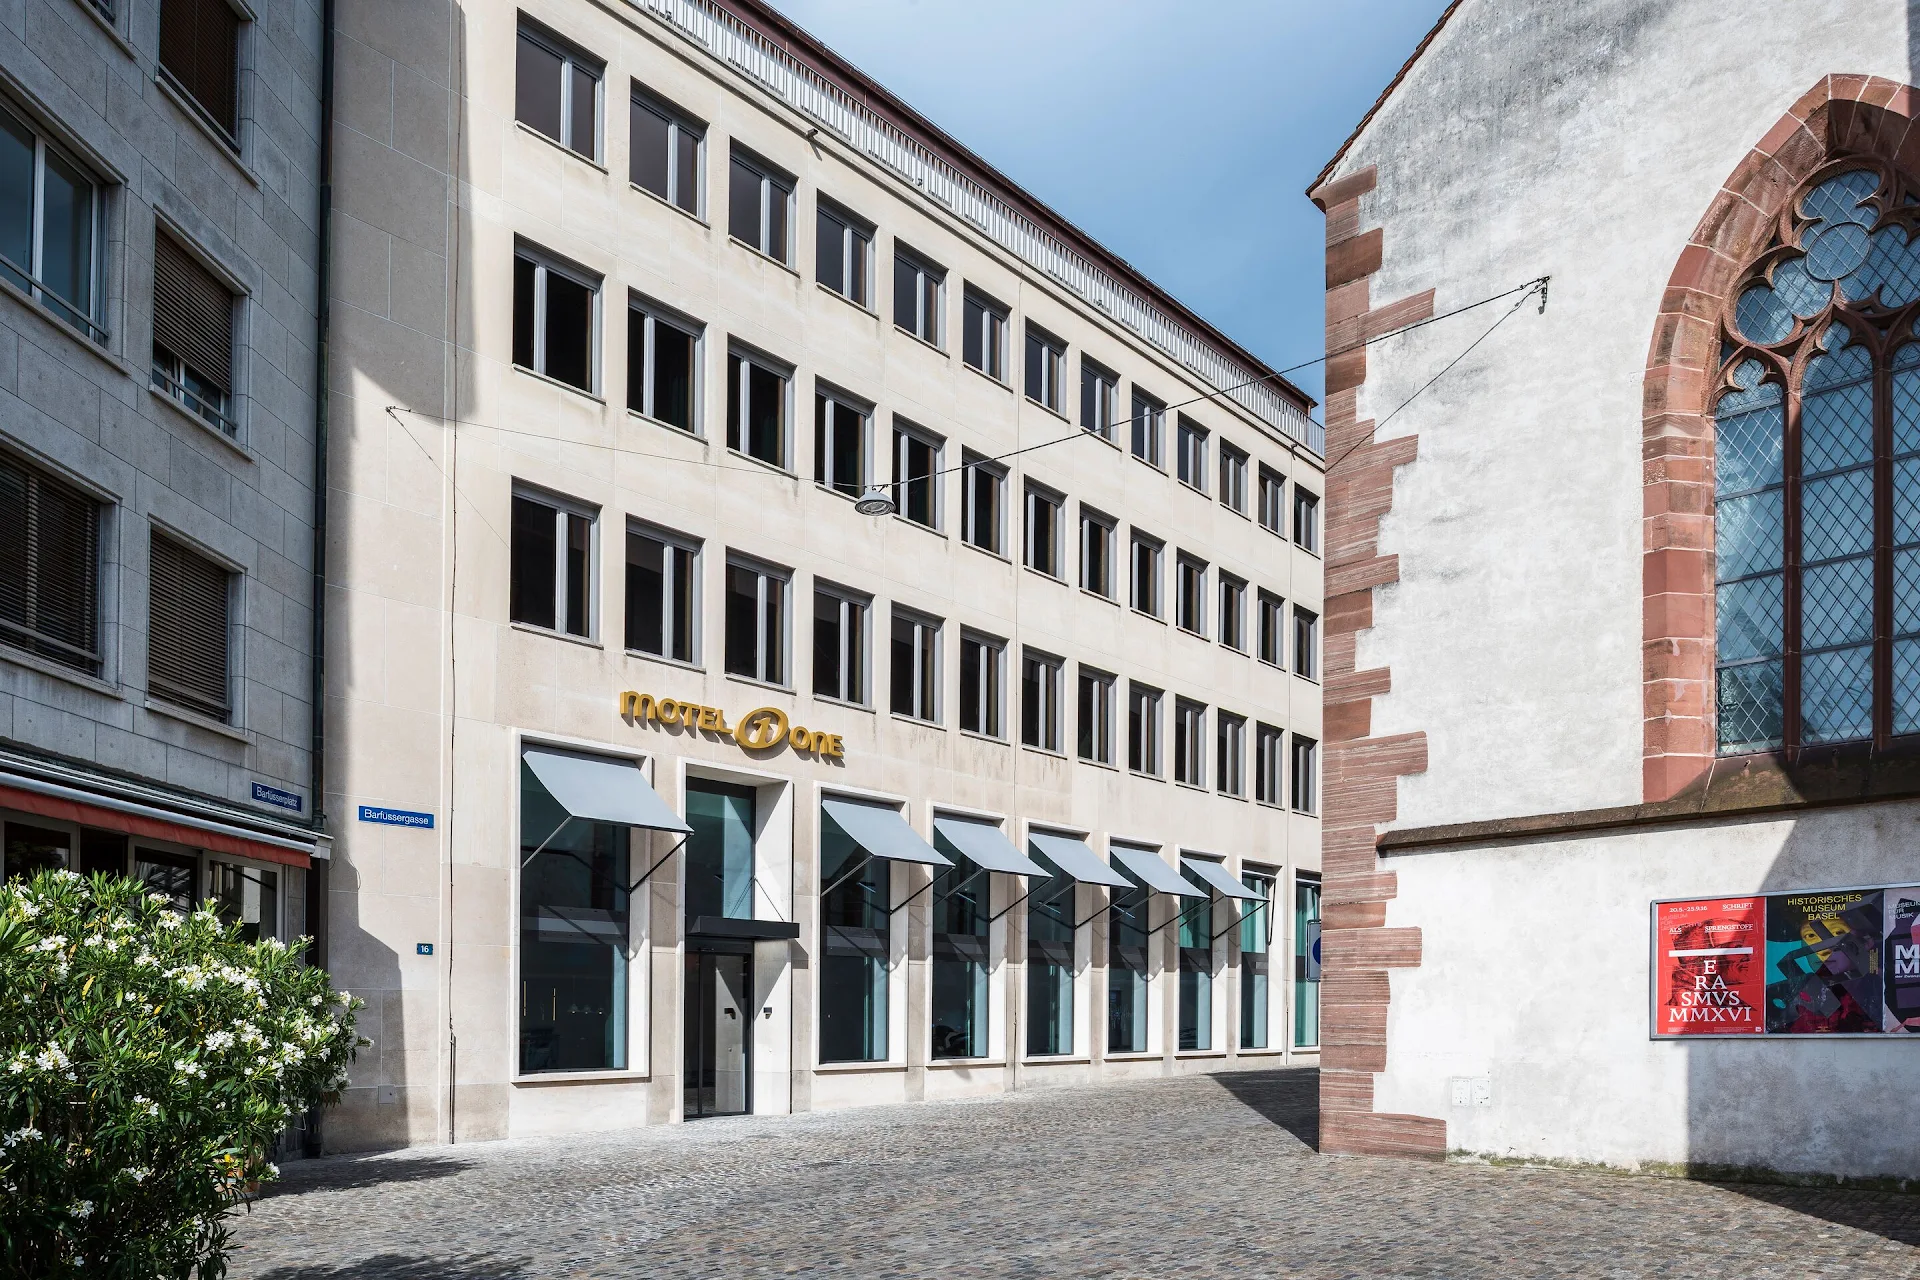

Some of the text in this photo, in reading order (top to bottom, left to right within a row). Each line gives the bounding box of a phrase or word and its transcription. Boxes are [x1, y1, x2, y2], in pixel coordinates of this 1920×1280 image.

[620, 690, 733, 734] MOTEL
[789, 726, 843, 757] ONE
[256, 787, 298, 807] Barfüsserplatz
[364, 809, 429, 825] Barfüssergasse
[1722, 902, 1753, 910] SCHRIFT
[1787, 894, 1862, 906] HISTORISCHES
[1802, 903, 1846, 912] MUSEUM
[1808, 912, 1840, 920] BASEL
[1888, 911, 1914, 920] MUSIK
[420, 945, 429, 953] 16
[1704, 960, 1716, 974] E
[1695, 975, 1727, 990] RA
[1682, 991, 1740, 1006] SMVS
[1669, 1007, 1751, 1022] MMXVI
